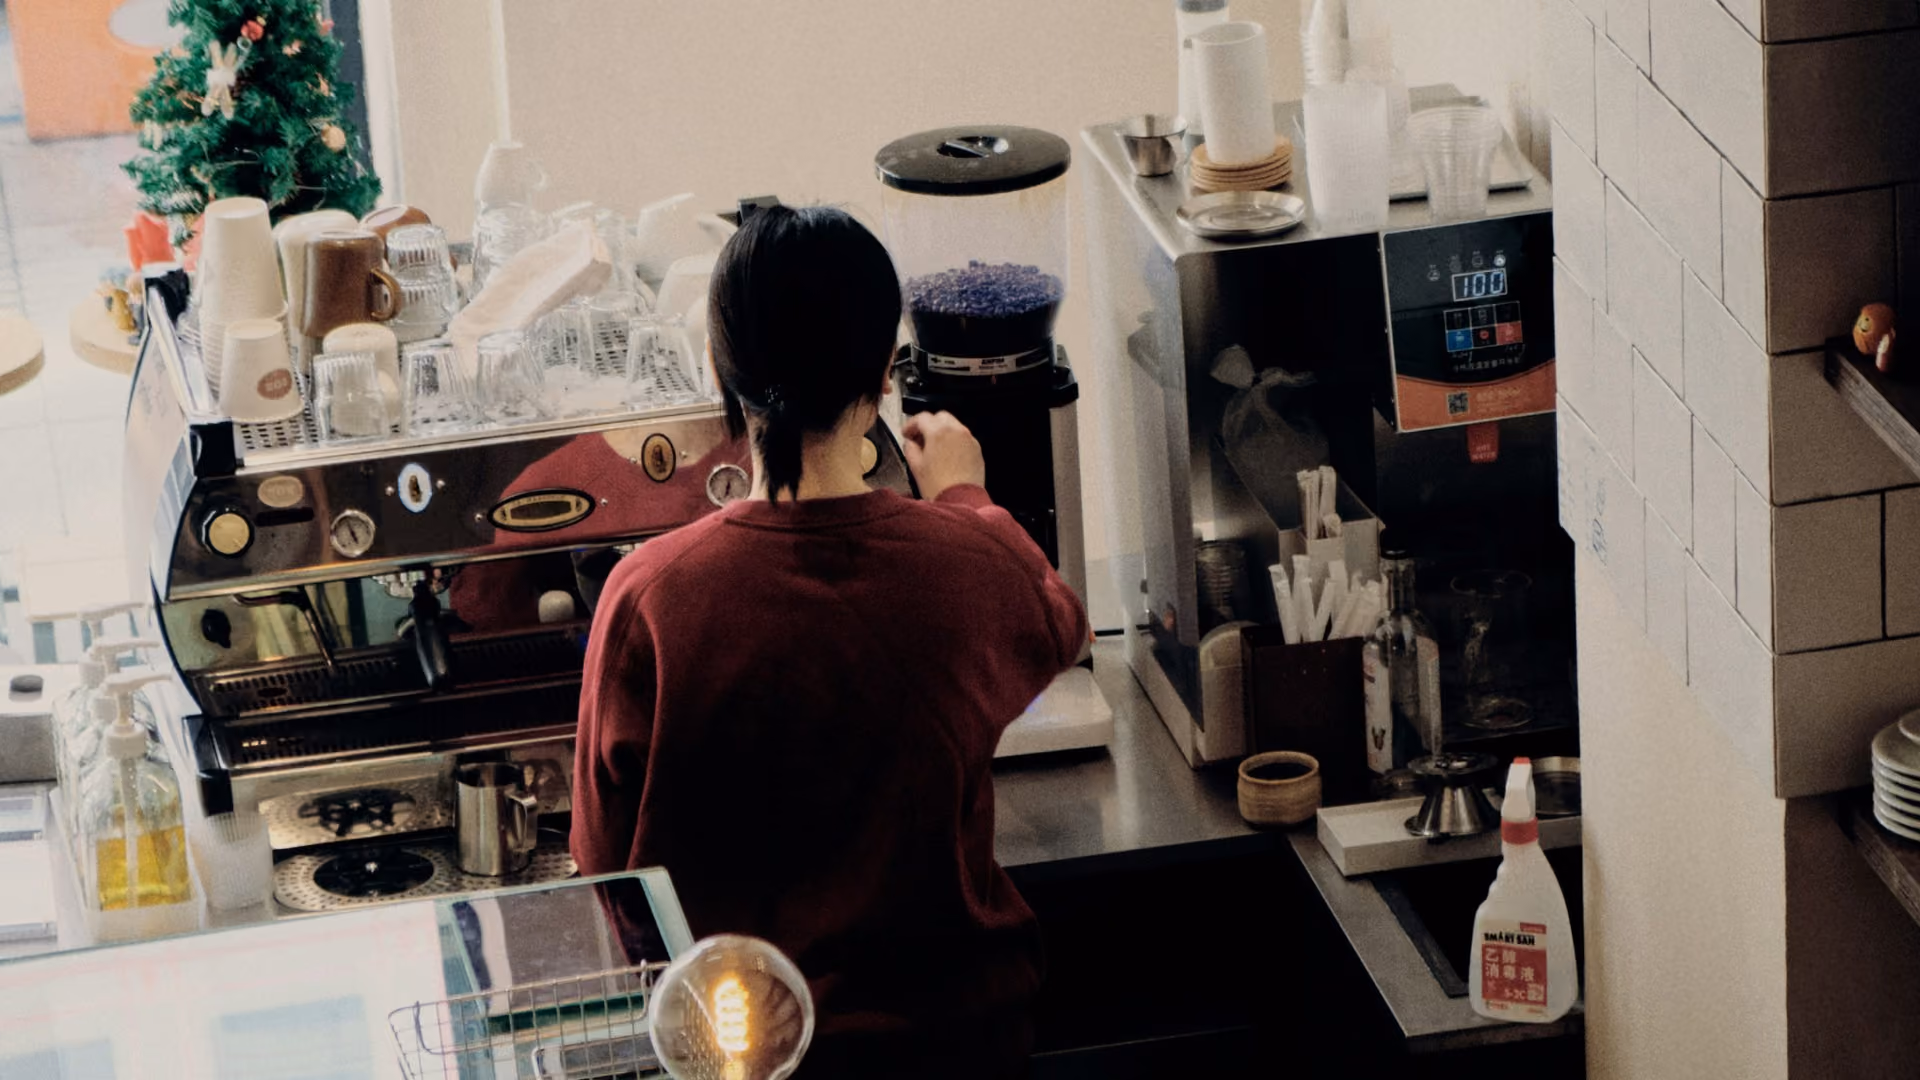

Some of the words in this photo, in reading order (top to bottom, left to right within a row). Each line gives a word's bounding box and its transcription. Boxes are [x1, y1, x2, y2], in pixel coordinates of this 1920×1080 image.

[1463, 272, 1503, 297] 100
[1484, 932, 1515, 944] SMART
[1516, 935, 1535, 945] SAN
